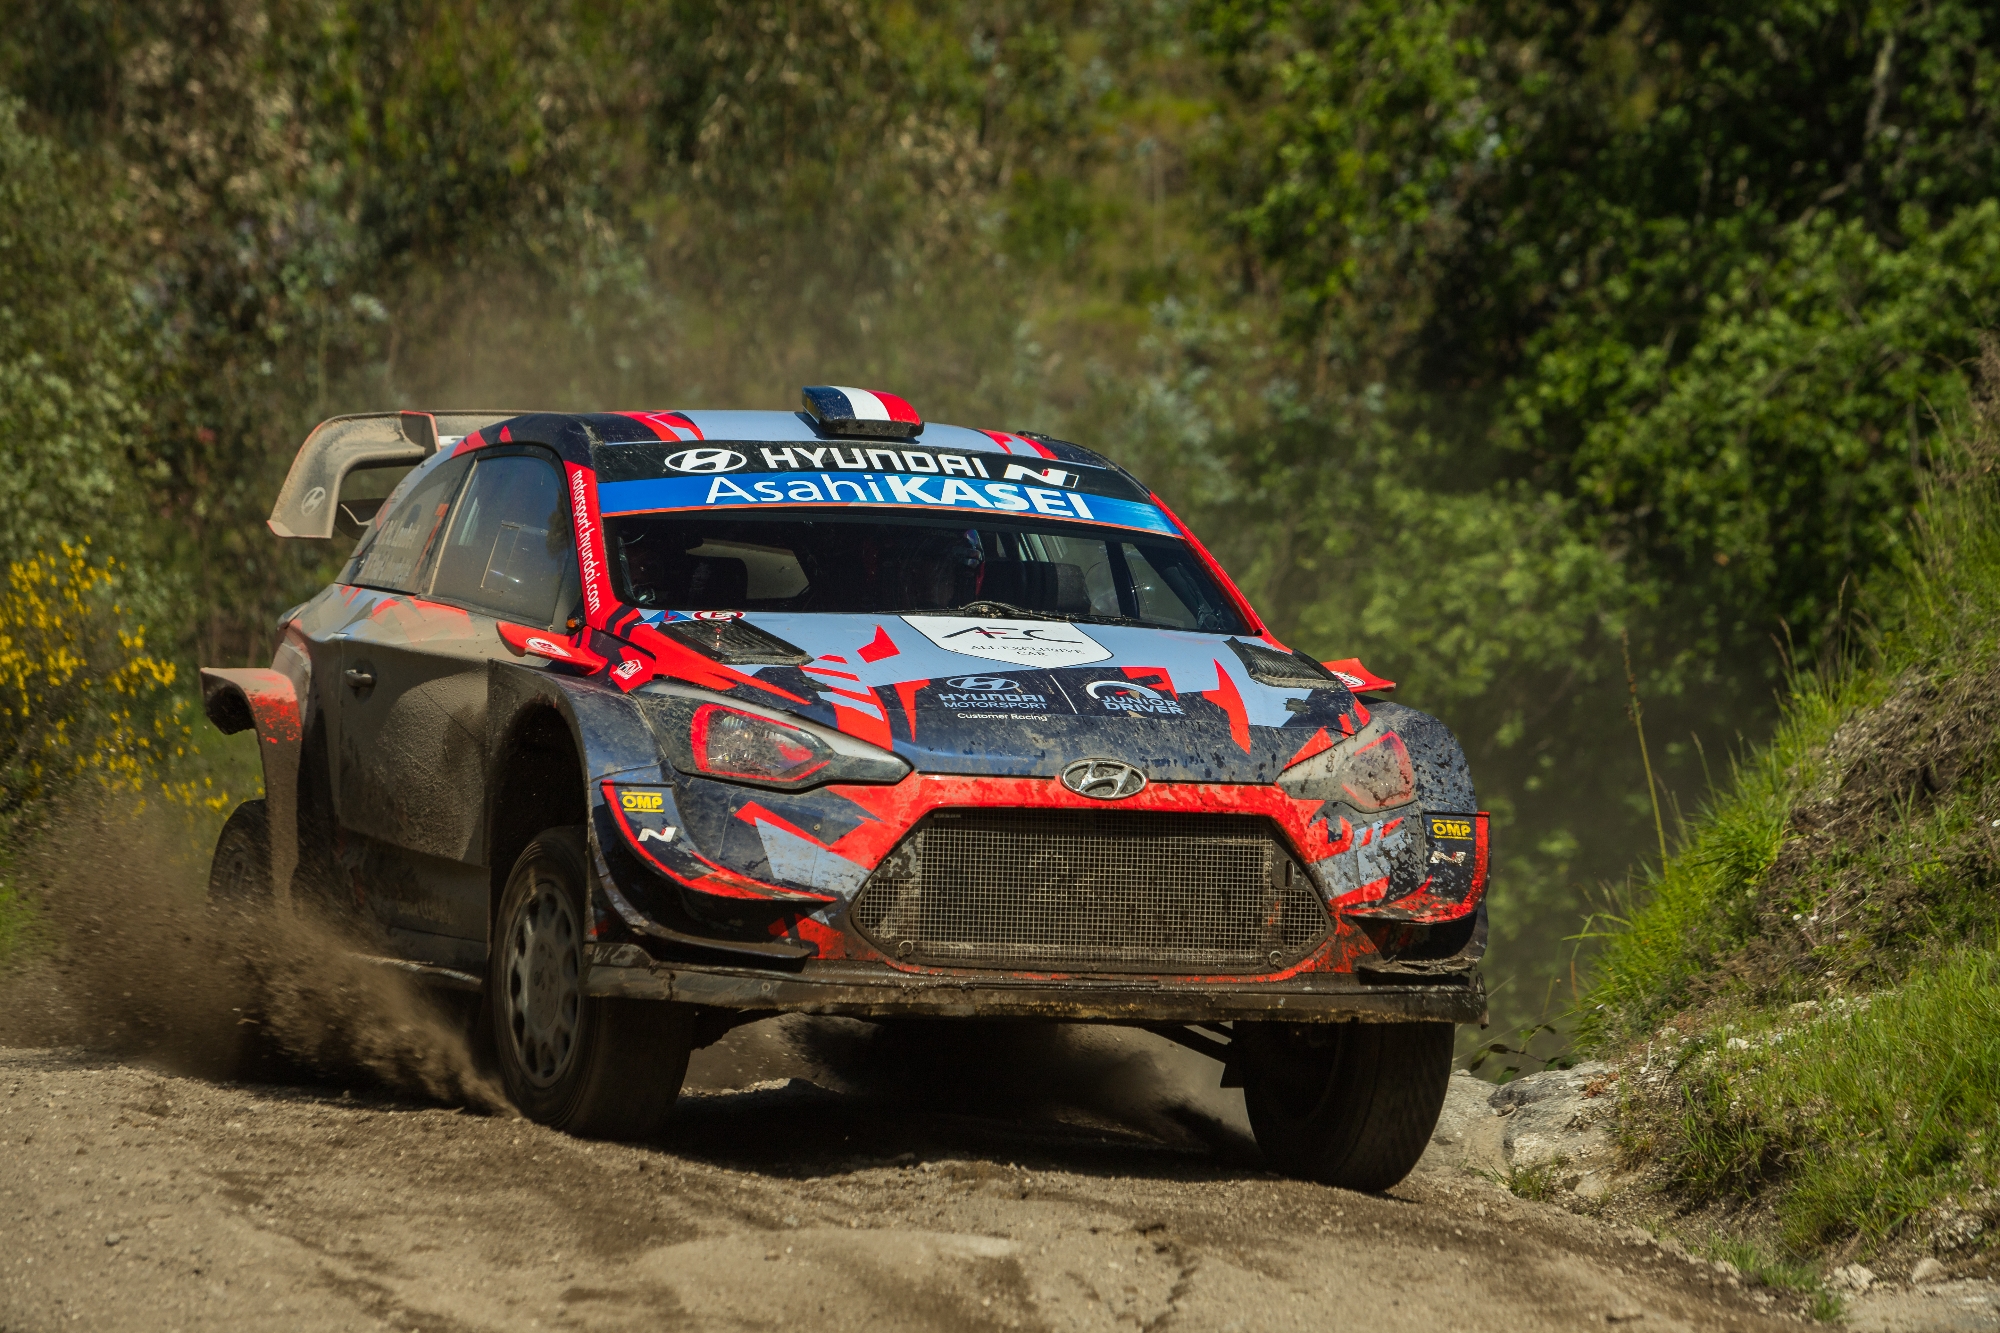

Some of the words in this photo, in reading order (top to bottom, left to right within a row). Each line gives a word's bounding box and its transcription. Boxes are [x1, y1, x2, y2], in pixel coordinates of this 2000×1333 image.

[759, 447, 990, 479] HYUNDAI
[705, 473, 1095, 520] AsahiKASEI
[571, 469, 601, 616] motorsport.hyundai.com
[938, 693, 1047, 703] HYUNDAI
[1101, 695, 1180, 708] JUNIOR
[944, 701, 1048, 711] MOTORSPORT
[1104, 703, 1187, 716] DRIVER
[957, 712, 1008, 720] Customer
[1011, 713, 1049, 722] Racing
[622, 795, 663, 809] OMP
[637, 826, 677, 843] N
[1432, 821, 1471, 838] OMP
